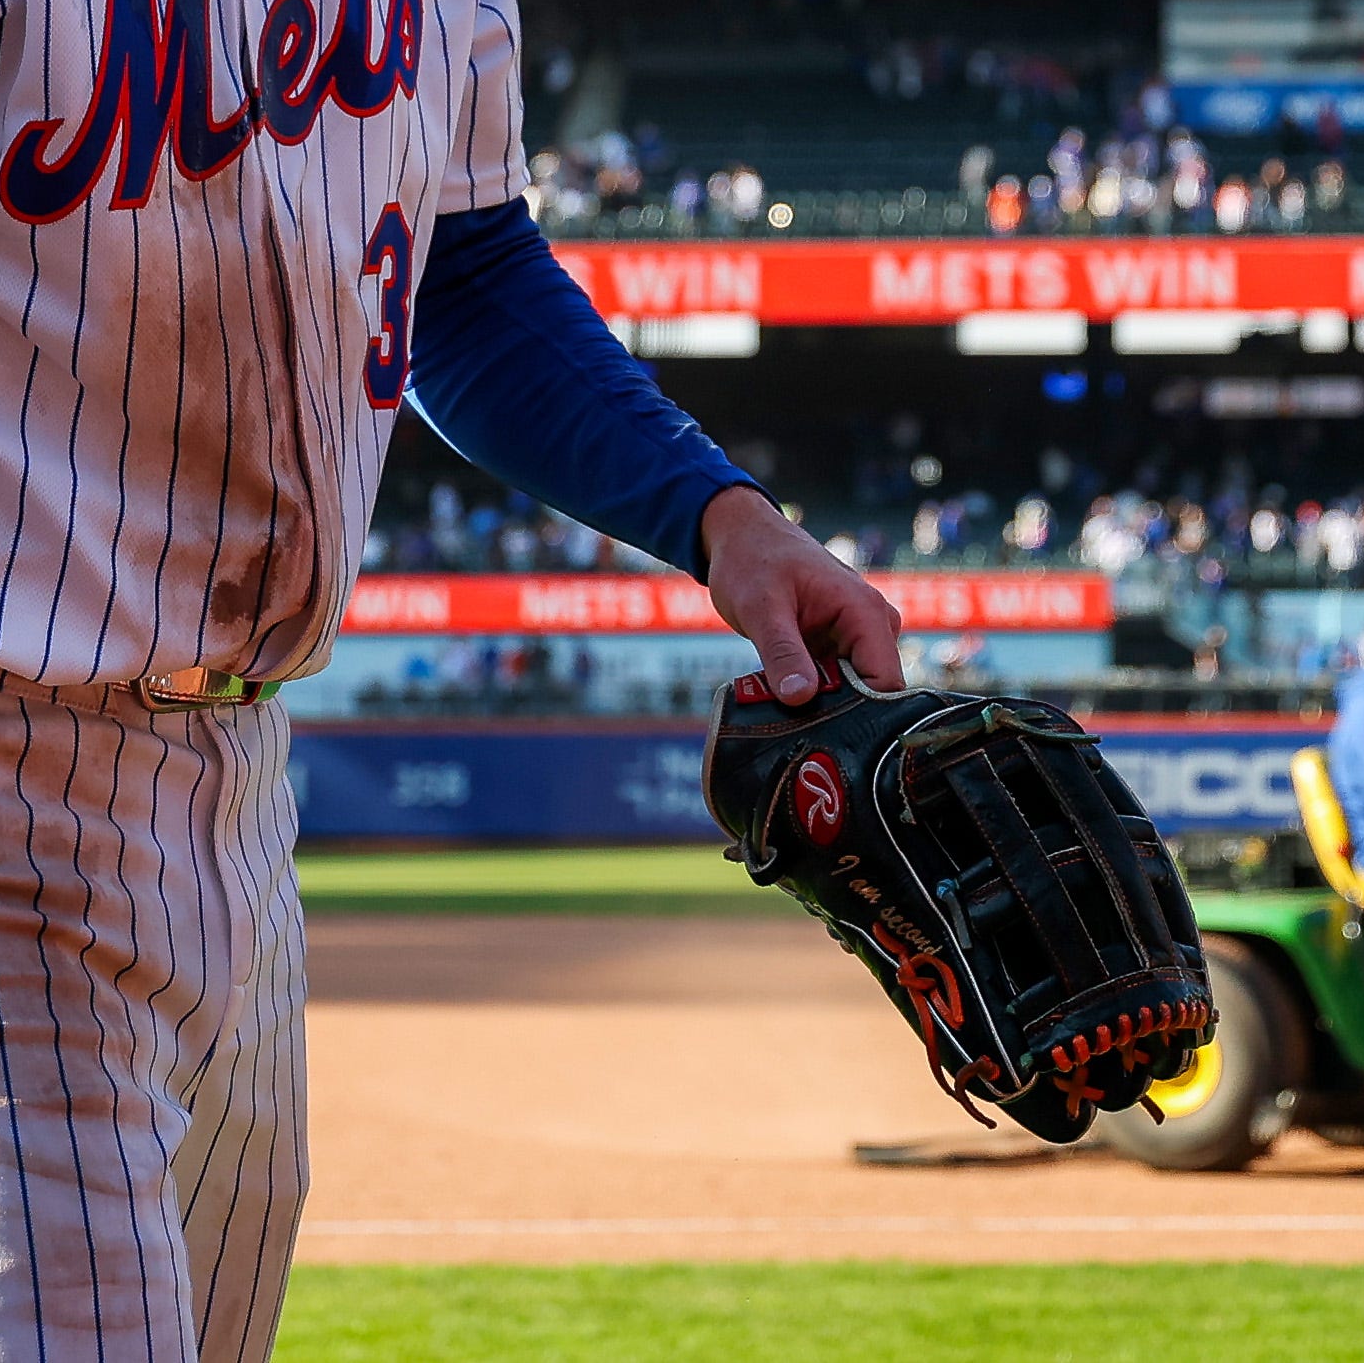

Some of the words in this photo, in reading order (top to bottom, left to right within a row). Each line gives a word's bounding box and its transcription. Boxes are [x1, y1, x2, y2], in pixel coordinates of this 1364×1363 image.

[609, 253, 762, 312] WIN
[871, 250, 1069, 311] METS
[1084, 250, 1235, 311] WIN
